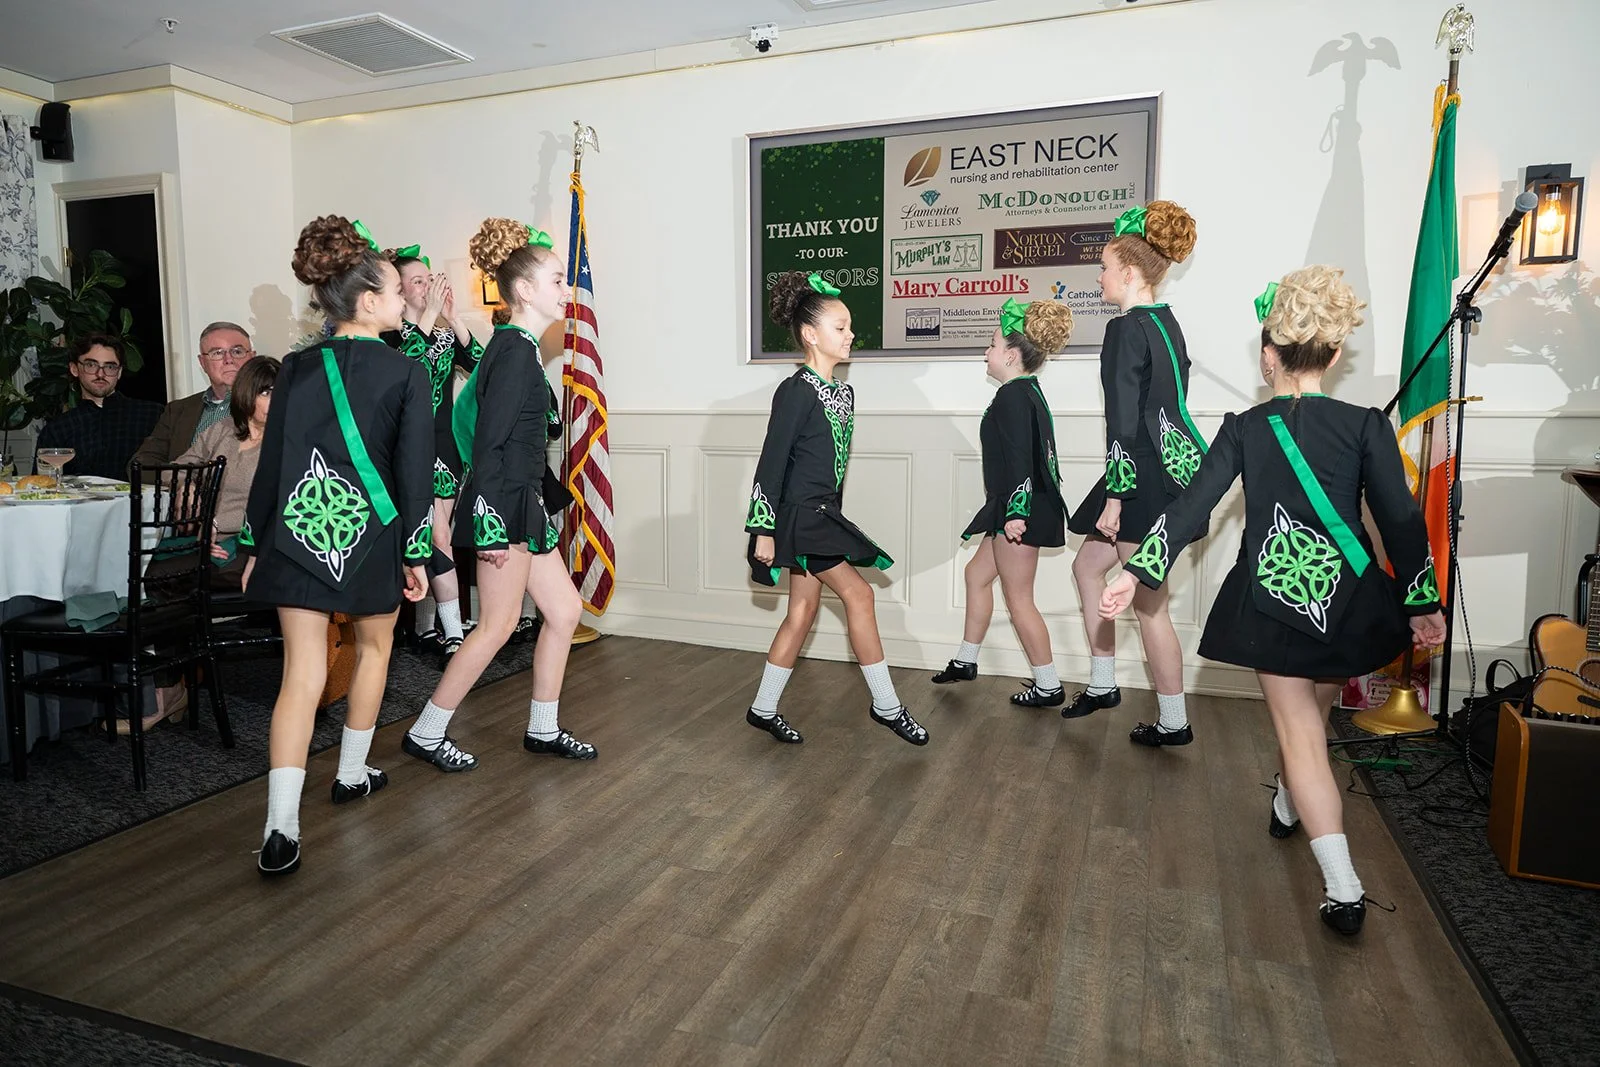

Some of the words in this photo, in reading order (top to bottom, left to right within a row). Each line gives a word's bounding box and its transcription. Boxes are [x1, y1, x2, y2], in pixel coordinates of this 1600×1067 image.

[951, 141, 1026, 170] EAST
[1034, 133, 1118, 163] NECK
[950, 173, 987, 184] nursing
[990, 170, 1009, 181] and
[1012, 165, 1080, 179] rehabilitation
[1083, 163, 1119, 173] center
[900, 203, 959, 220] Lamonica
[1005, 208, 1042, 217] Attorneys
[1053, 204, 1097, 214] Counselors
[766, 220, 833, 239] THANK
[837, 216, 879, 234] YOU
[904, 217, 962, 231] JEWELERS
[1007, 231, 1066, 247] NORTON
[1080, 233, 1101, 242] Since
[1104, 232, 1113, 241] 18
[895, 240, 951, 270] MURPHY'S
[932, 255, 951, 266] LAW
[1002, 247, 1013, 260] &
[1013, 245, 1066, 265] SIEGEL
[766, 267, 879, 290] SSORS
[893, 279, 941, 298] Mary
[946, 273, 1029, 296] Carroll's
[943, 308, 980, 317] Middleton
[1072, 308, 1099, 316] niversity
[909, 316, 937, 330] MEI
